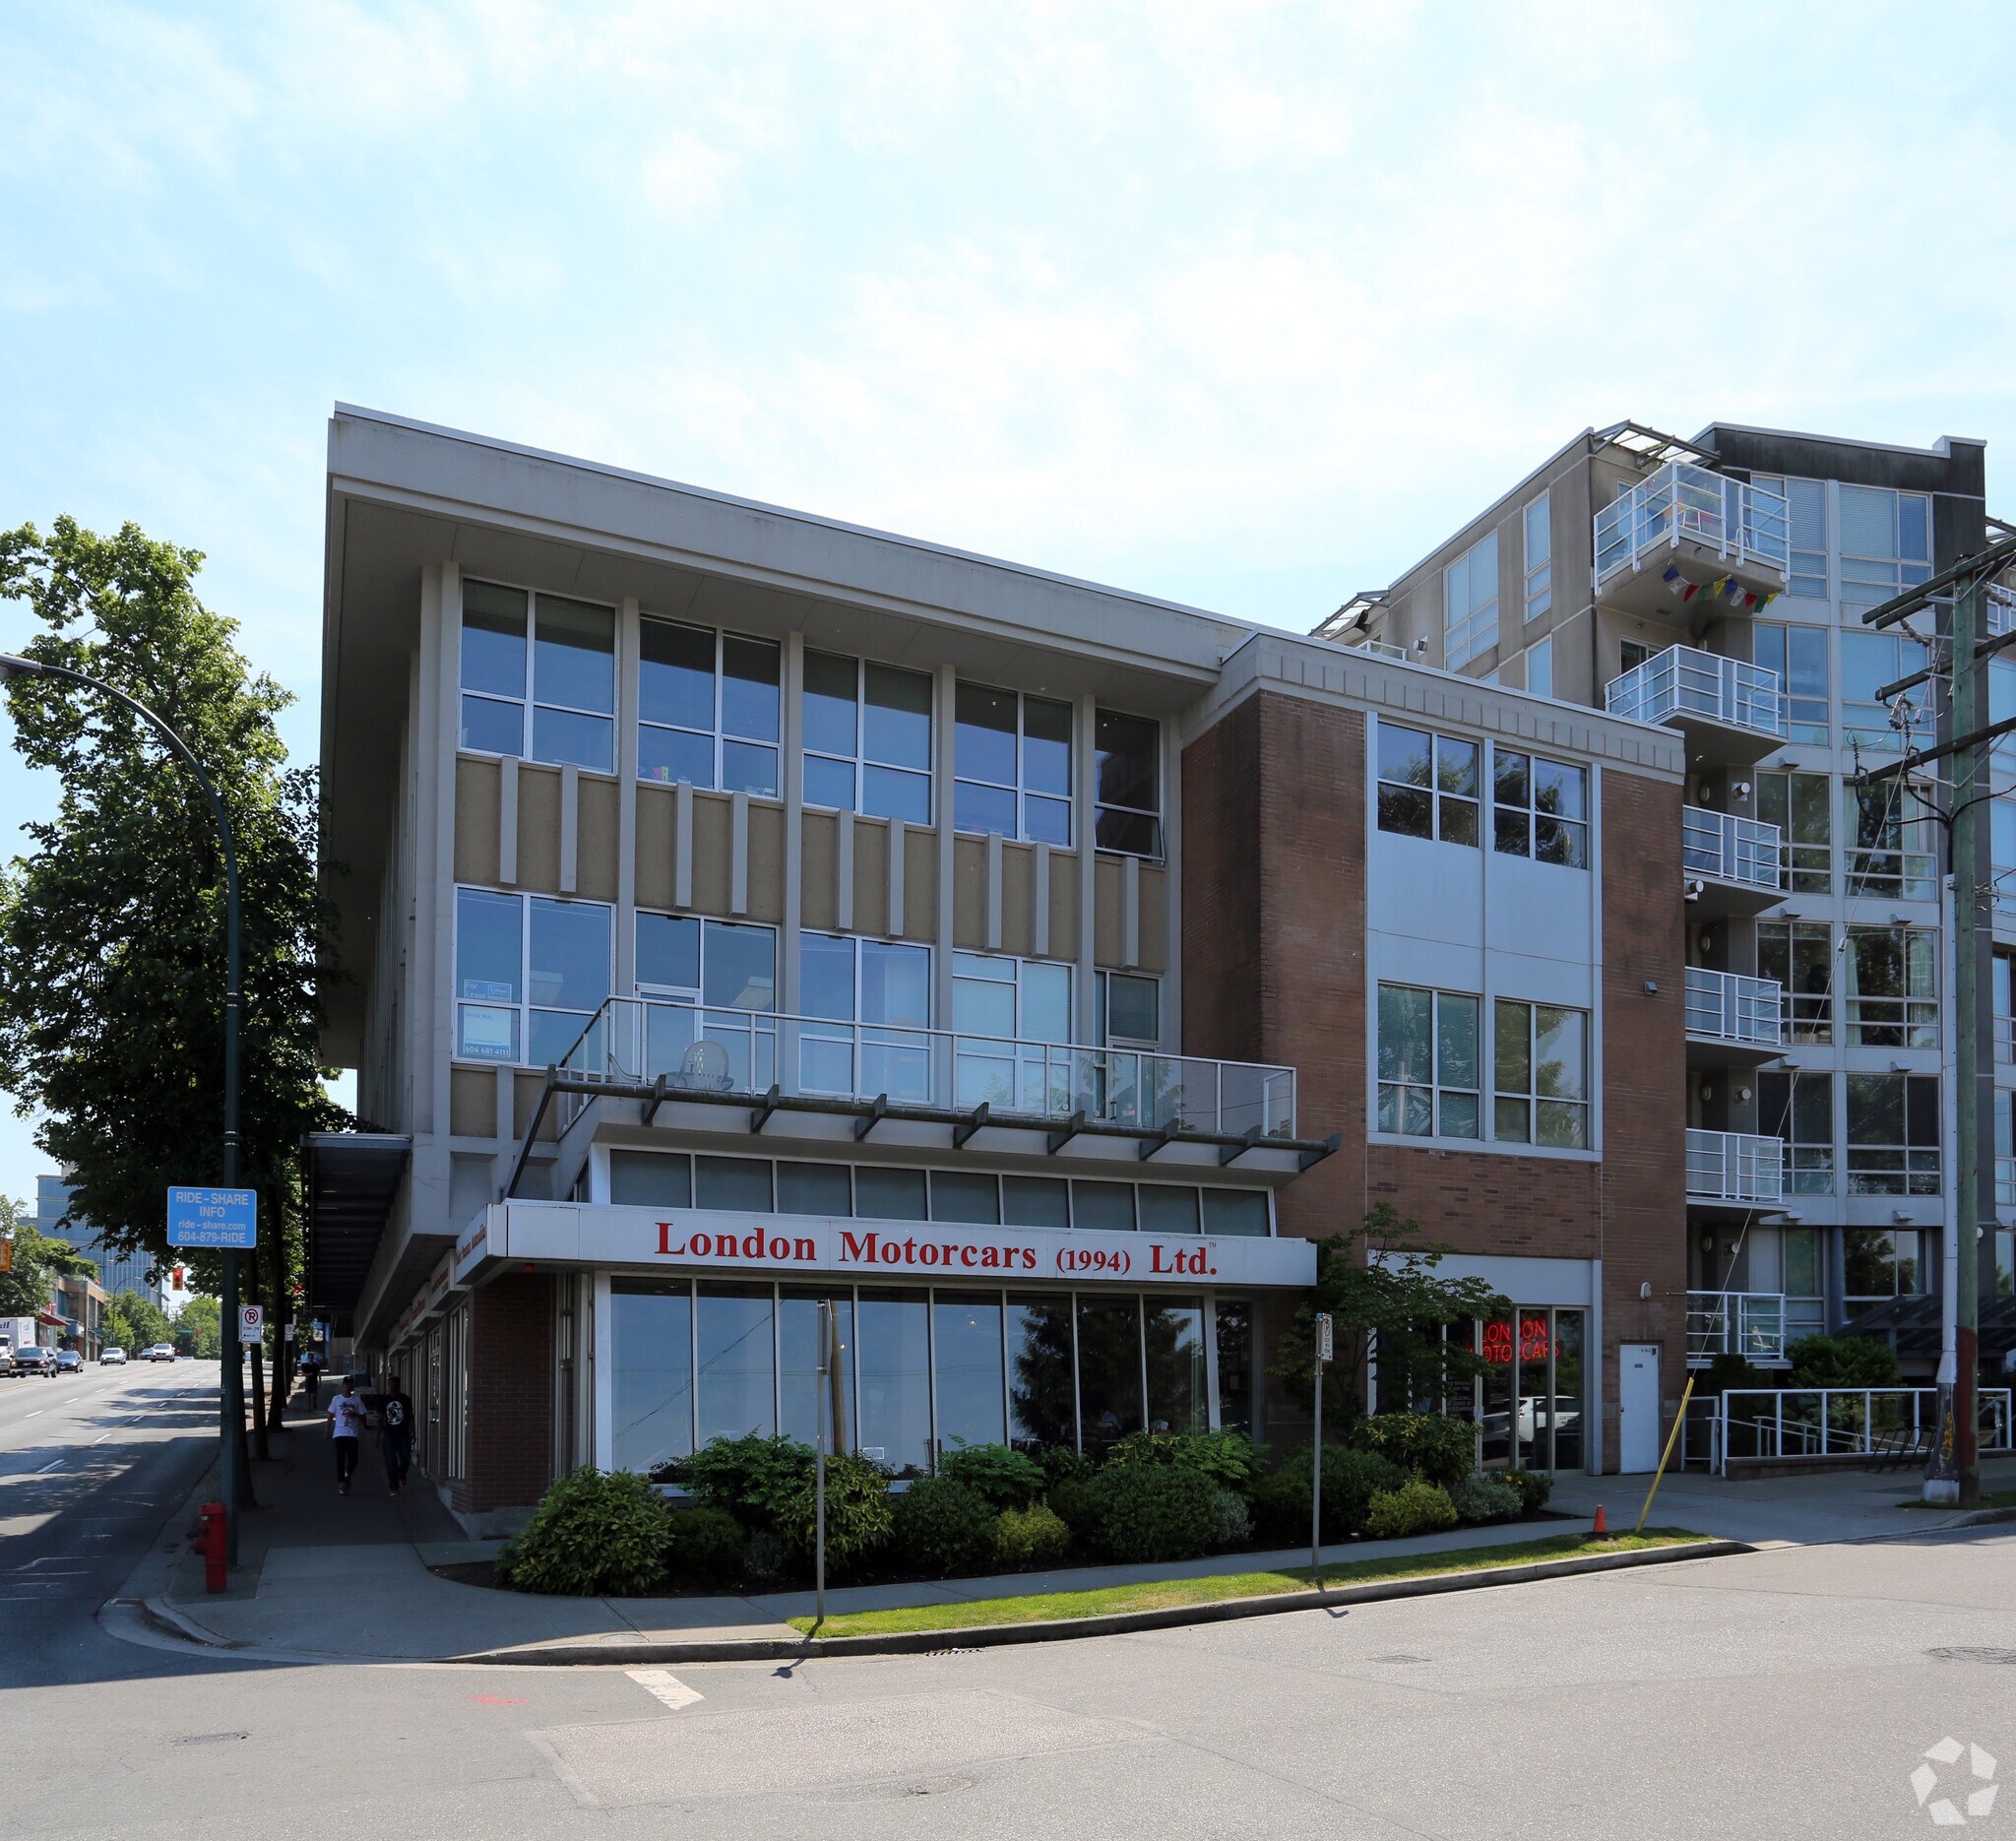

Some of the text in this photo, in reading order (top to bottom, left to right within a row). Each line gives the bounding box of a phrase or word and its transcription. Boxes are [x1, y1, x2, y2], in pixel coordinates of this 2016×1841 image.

[466, 990, 486, 999] Lease
[199, 1206, 225, 1218] INFO
[178, 1231, 246, 1243] 604-879-RIDE
[655, 1222, 817, 1261] London
[838, 1231, 1037, 1269] Motorcars
[1056, 1247, 1131, 1275] (1994)
[1150, 1244, 1218, 1275] Ltd.
[1481, 1319, 1546, 1343] ONON
